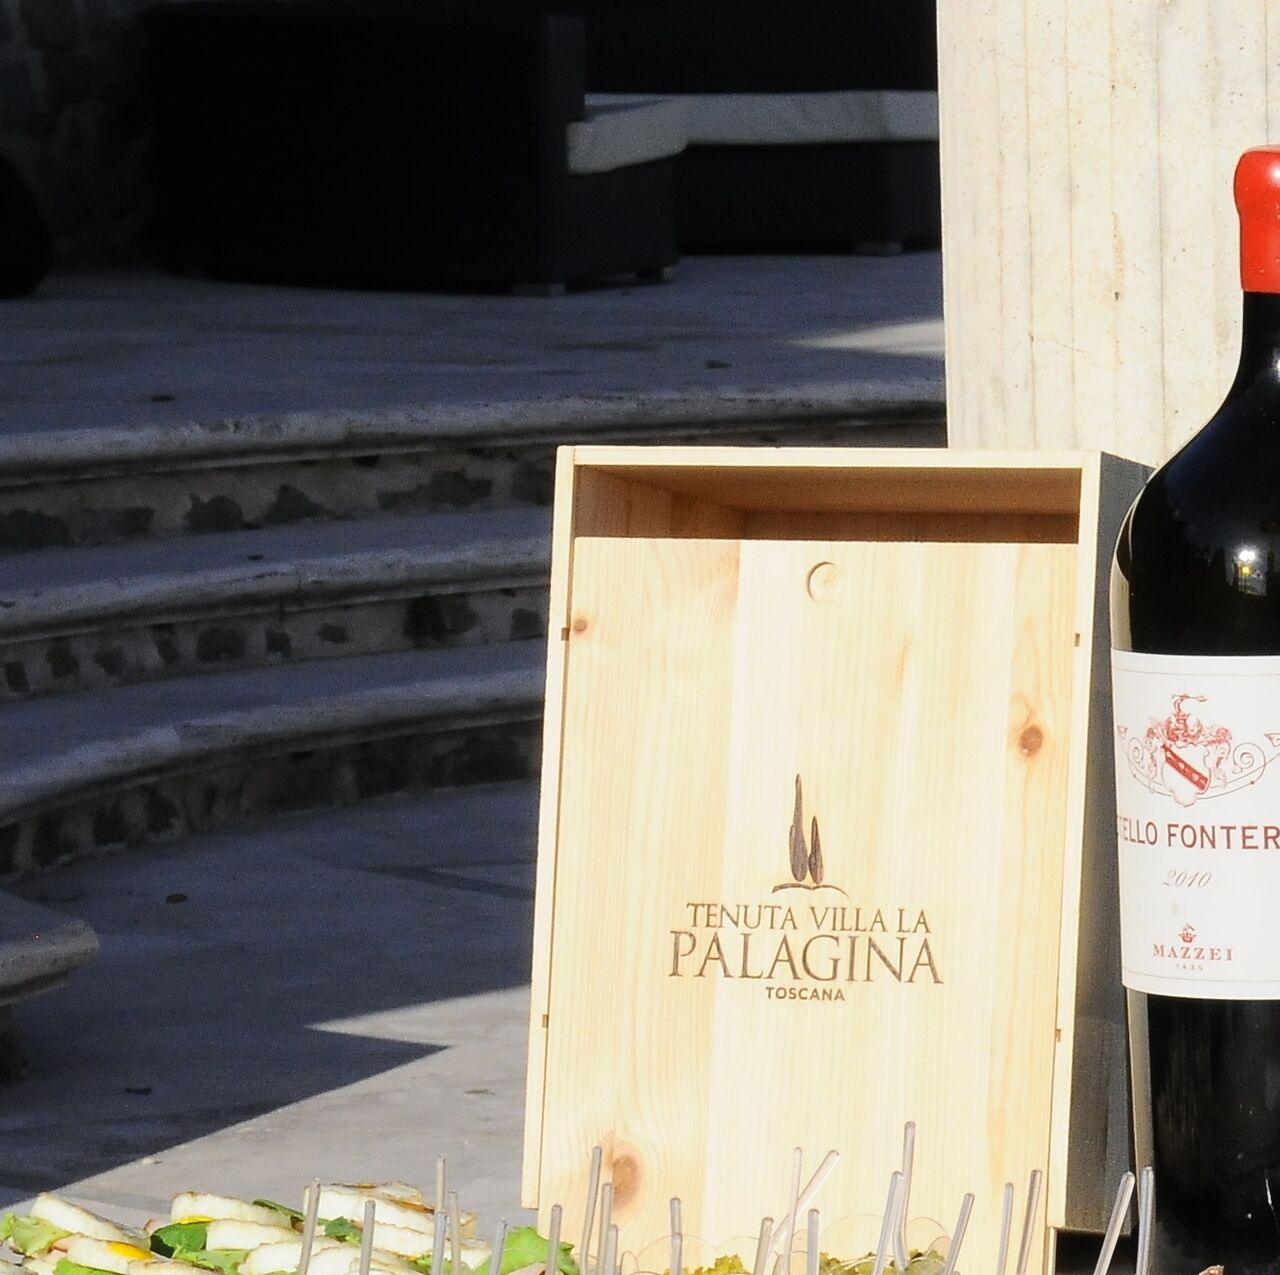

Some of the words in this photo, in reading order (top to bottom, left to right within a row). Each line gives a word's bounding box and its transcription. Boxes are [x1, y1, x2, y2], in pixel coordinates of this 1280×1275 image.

[1163, 869, 1212, 888] 2010
[686, 902, 798, 930] TENUTA
[809, 906, 888, 933] VILLA
[897, 908, 932, 934] LA
[668, 930, 944, 985] PALAGINA
[1152, 943, 1233, 961] MAZZEI
[765, 986, 845, 1002] TOSCANA
